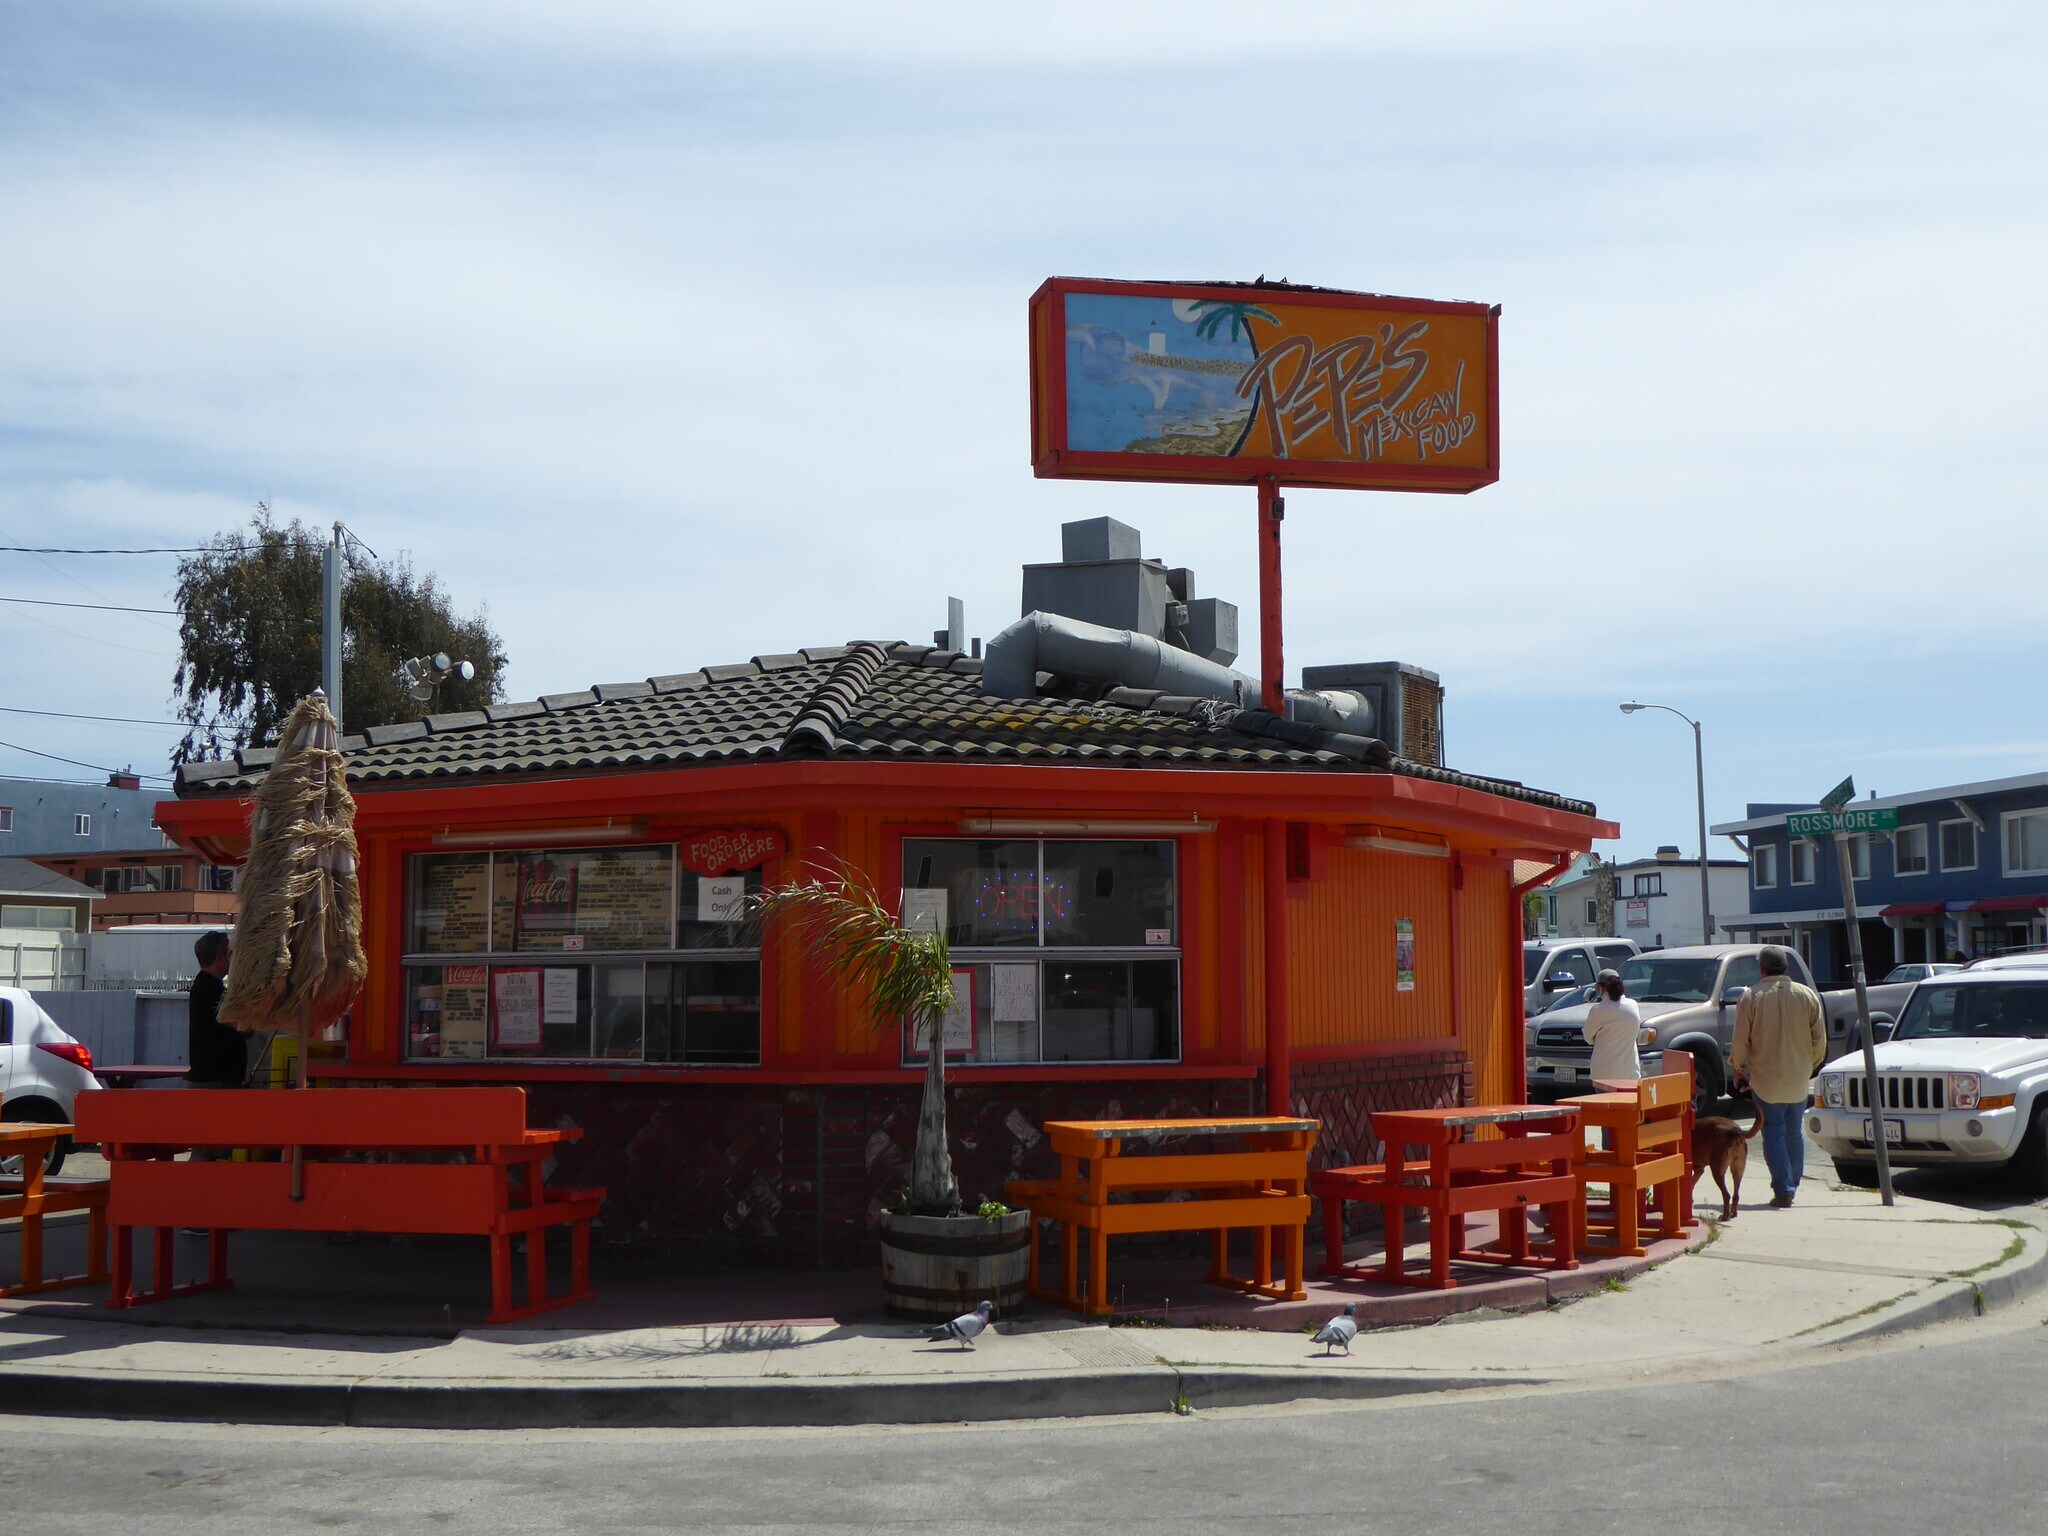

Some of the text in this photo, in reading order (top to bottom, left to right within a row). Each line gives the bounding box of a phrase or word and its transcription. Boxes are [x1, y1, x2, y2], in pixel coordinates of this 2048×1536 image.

[1235, 320, 1429, 460] PEPE'S
[1357, 359, 1466, 462] MEXICAN
[1417, 412, 1476, 461] FOOD
[1789, 811, 1894, 833] ROSSMORE DR
[690, 835, 728, 863] FOOD
[707, 832, 750, 871] ORDER
[738, 836, 776, 865] HERE
[711, 886, 732, 895] Cash
[979, 885, 1063, 918] OPEN
[1867, 1128, 1899, 1139] 6414
